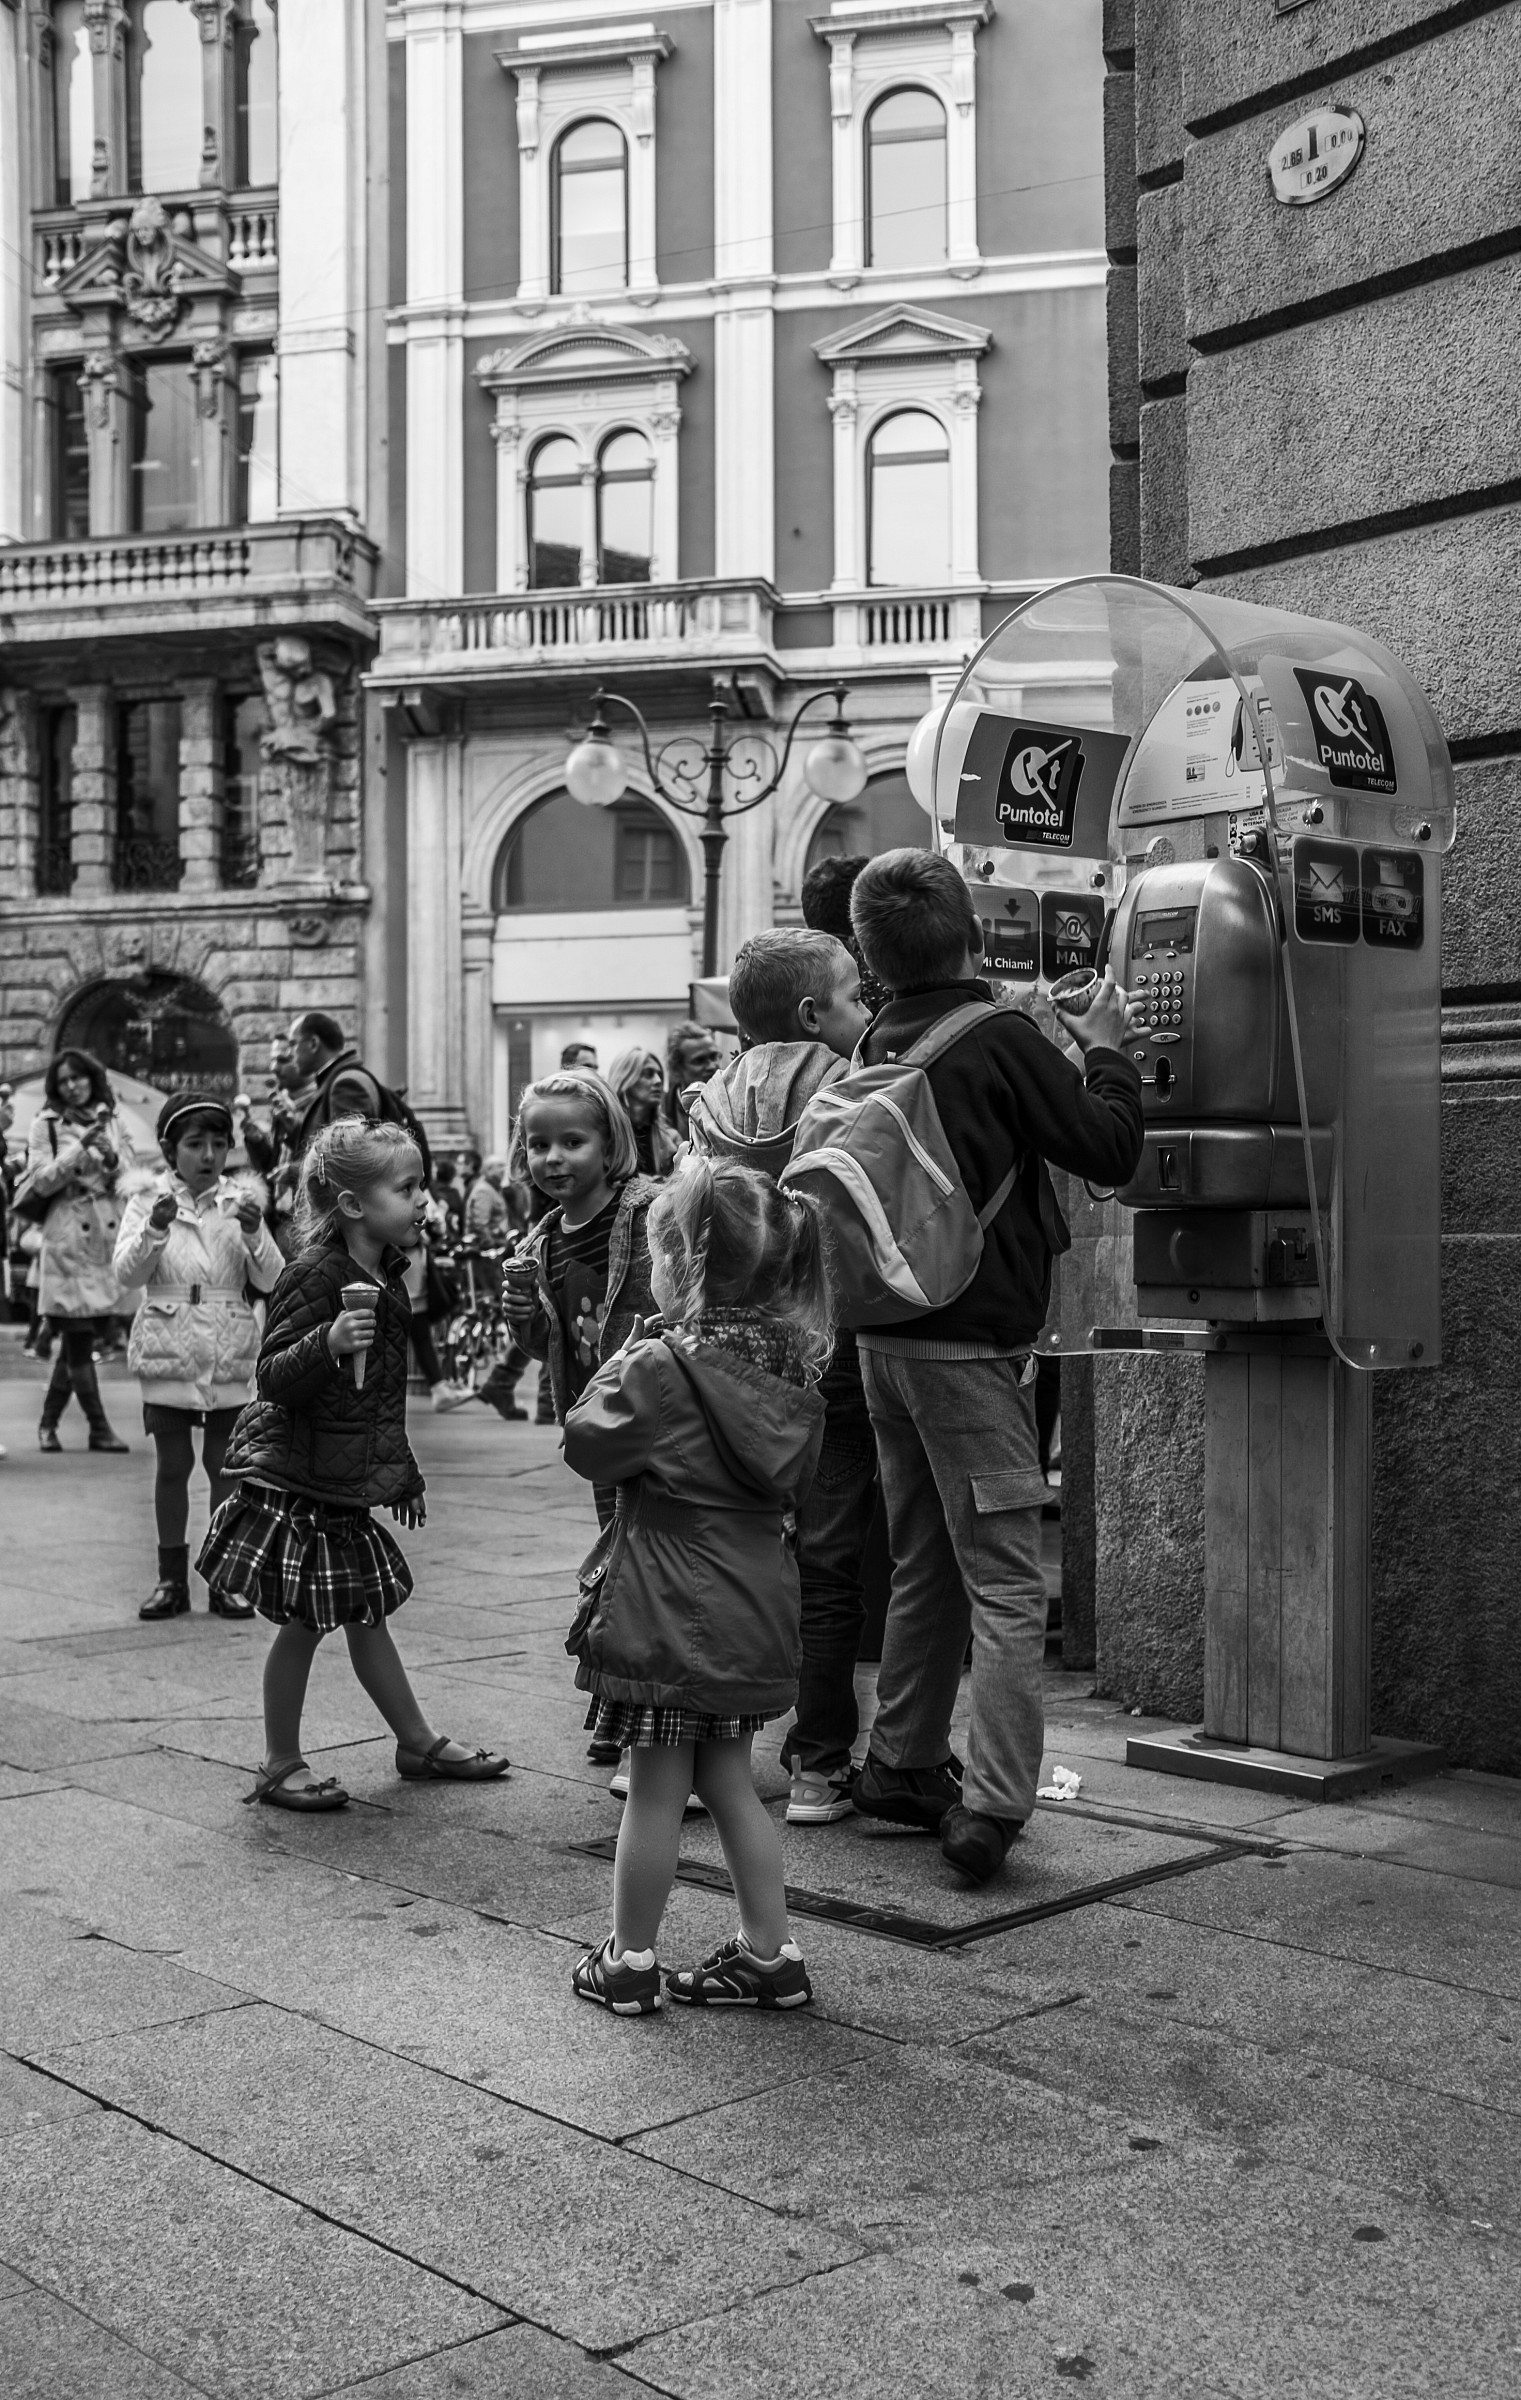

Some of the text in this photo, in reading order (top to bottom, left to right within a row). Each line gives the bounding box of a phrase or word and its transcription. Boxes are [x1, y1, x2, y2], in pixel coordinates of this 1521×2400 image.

[1320, 744, 1385, 773] Puntotel
[1367, 777, 1395, 788] TELECOM
[999, 803, 1064, 827] Puntotel
[1042, 831, 1071, 841] TELECOM
[1313, 905, 1342, 924] SMS
[1379, 919, 1407, 937] FAX
[994, 957, 1034, 970] Chiami?
[1056, 950, 1092, 966] MAIL
[1159, 1034, 1169, 1042] OK
